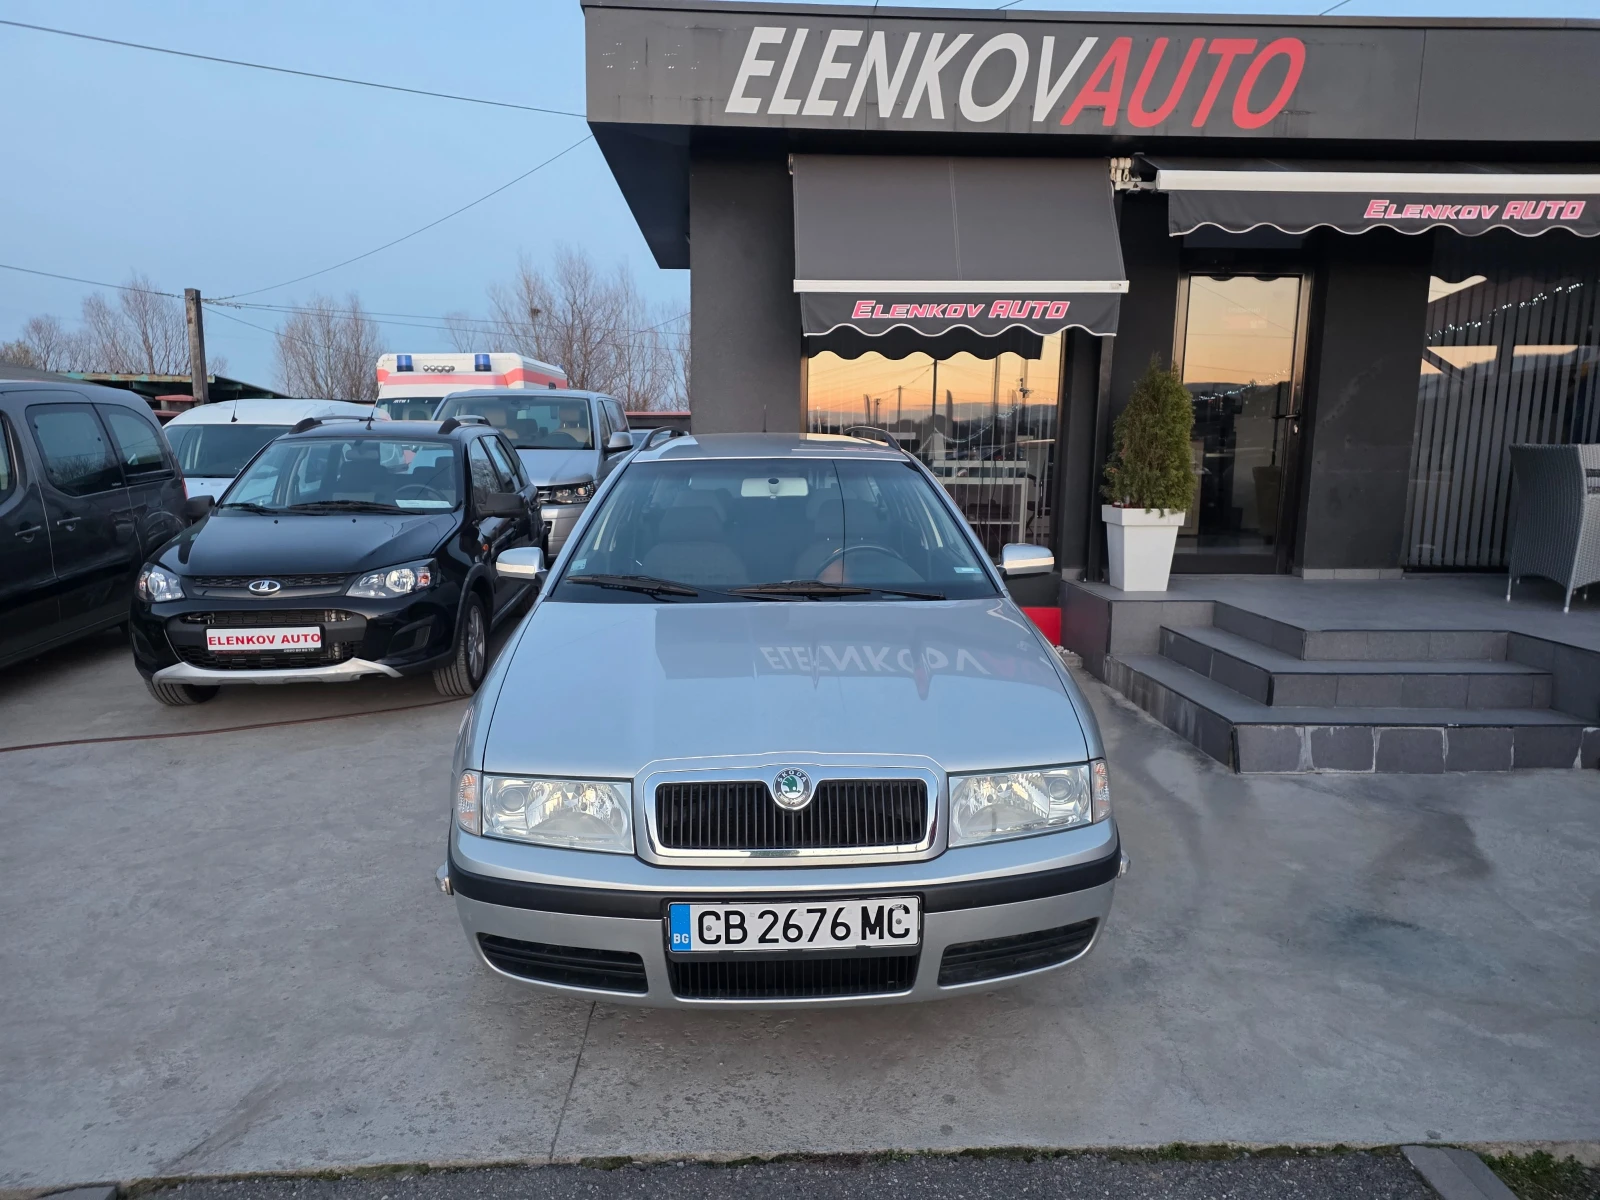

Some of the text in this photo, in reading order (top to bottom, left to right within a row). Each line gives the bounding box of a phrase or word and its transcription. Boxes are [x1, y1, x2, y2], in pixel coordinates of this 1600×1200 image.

[1501, 200, 1586, 220] AUTO
[988, 300, 1070, 319] AUTO
[208, 633, 320, 645] ELENKOV AUTO
[697, 904, 911, 945] CB 2676 MC
[673, 933, 689, 944] BG
